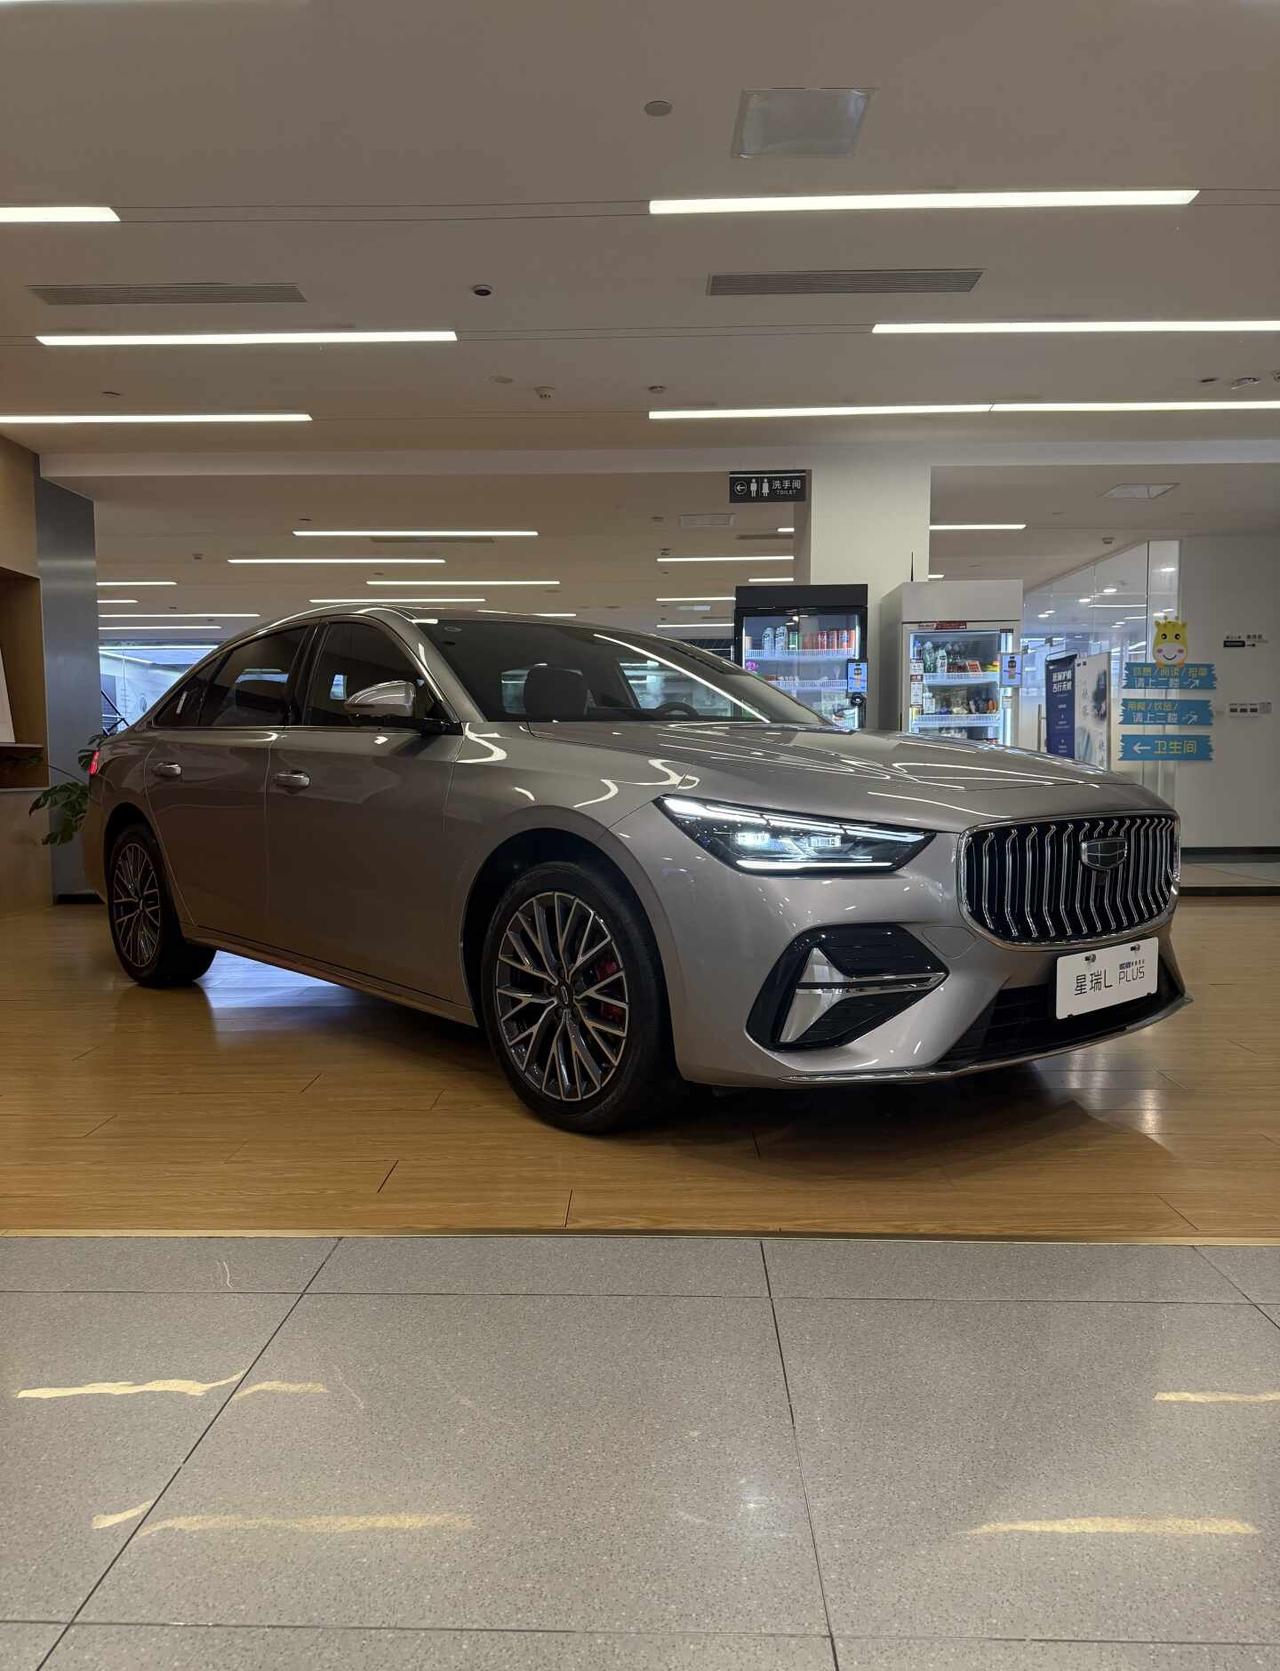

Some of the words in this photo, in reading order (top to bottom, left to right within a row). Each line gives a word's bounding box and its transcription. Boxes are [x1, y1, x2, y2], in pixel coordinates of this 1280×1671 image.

[772, 479, 801, 489] 洗手间
[1134, 677, 1180, 688] 请上二楼
[1132, 712, 1178, 723] 请上二楼
[1153, 740, 1197, 754] 卫生间
[1074, 969, 1113, 996] 星瑞L
[1118, 966, 1145, 984] PLUS
